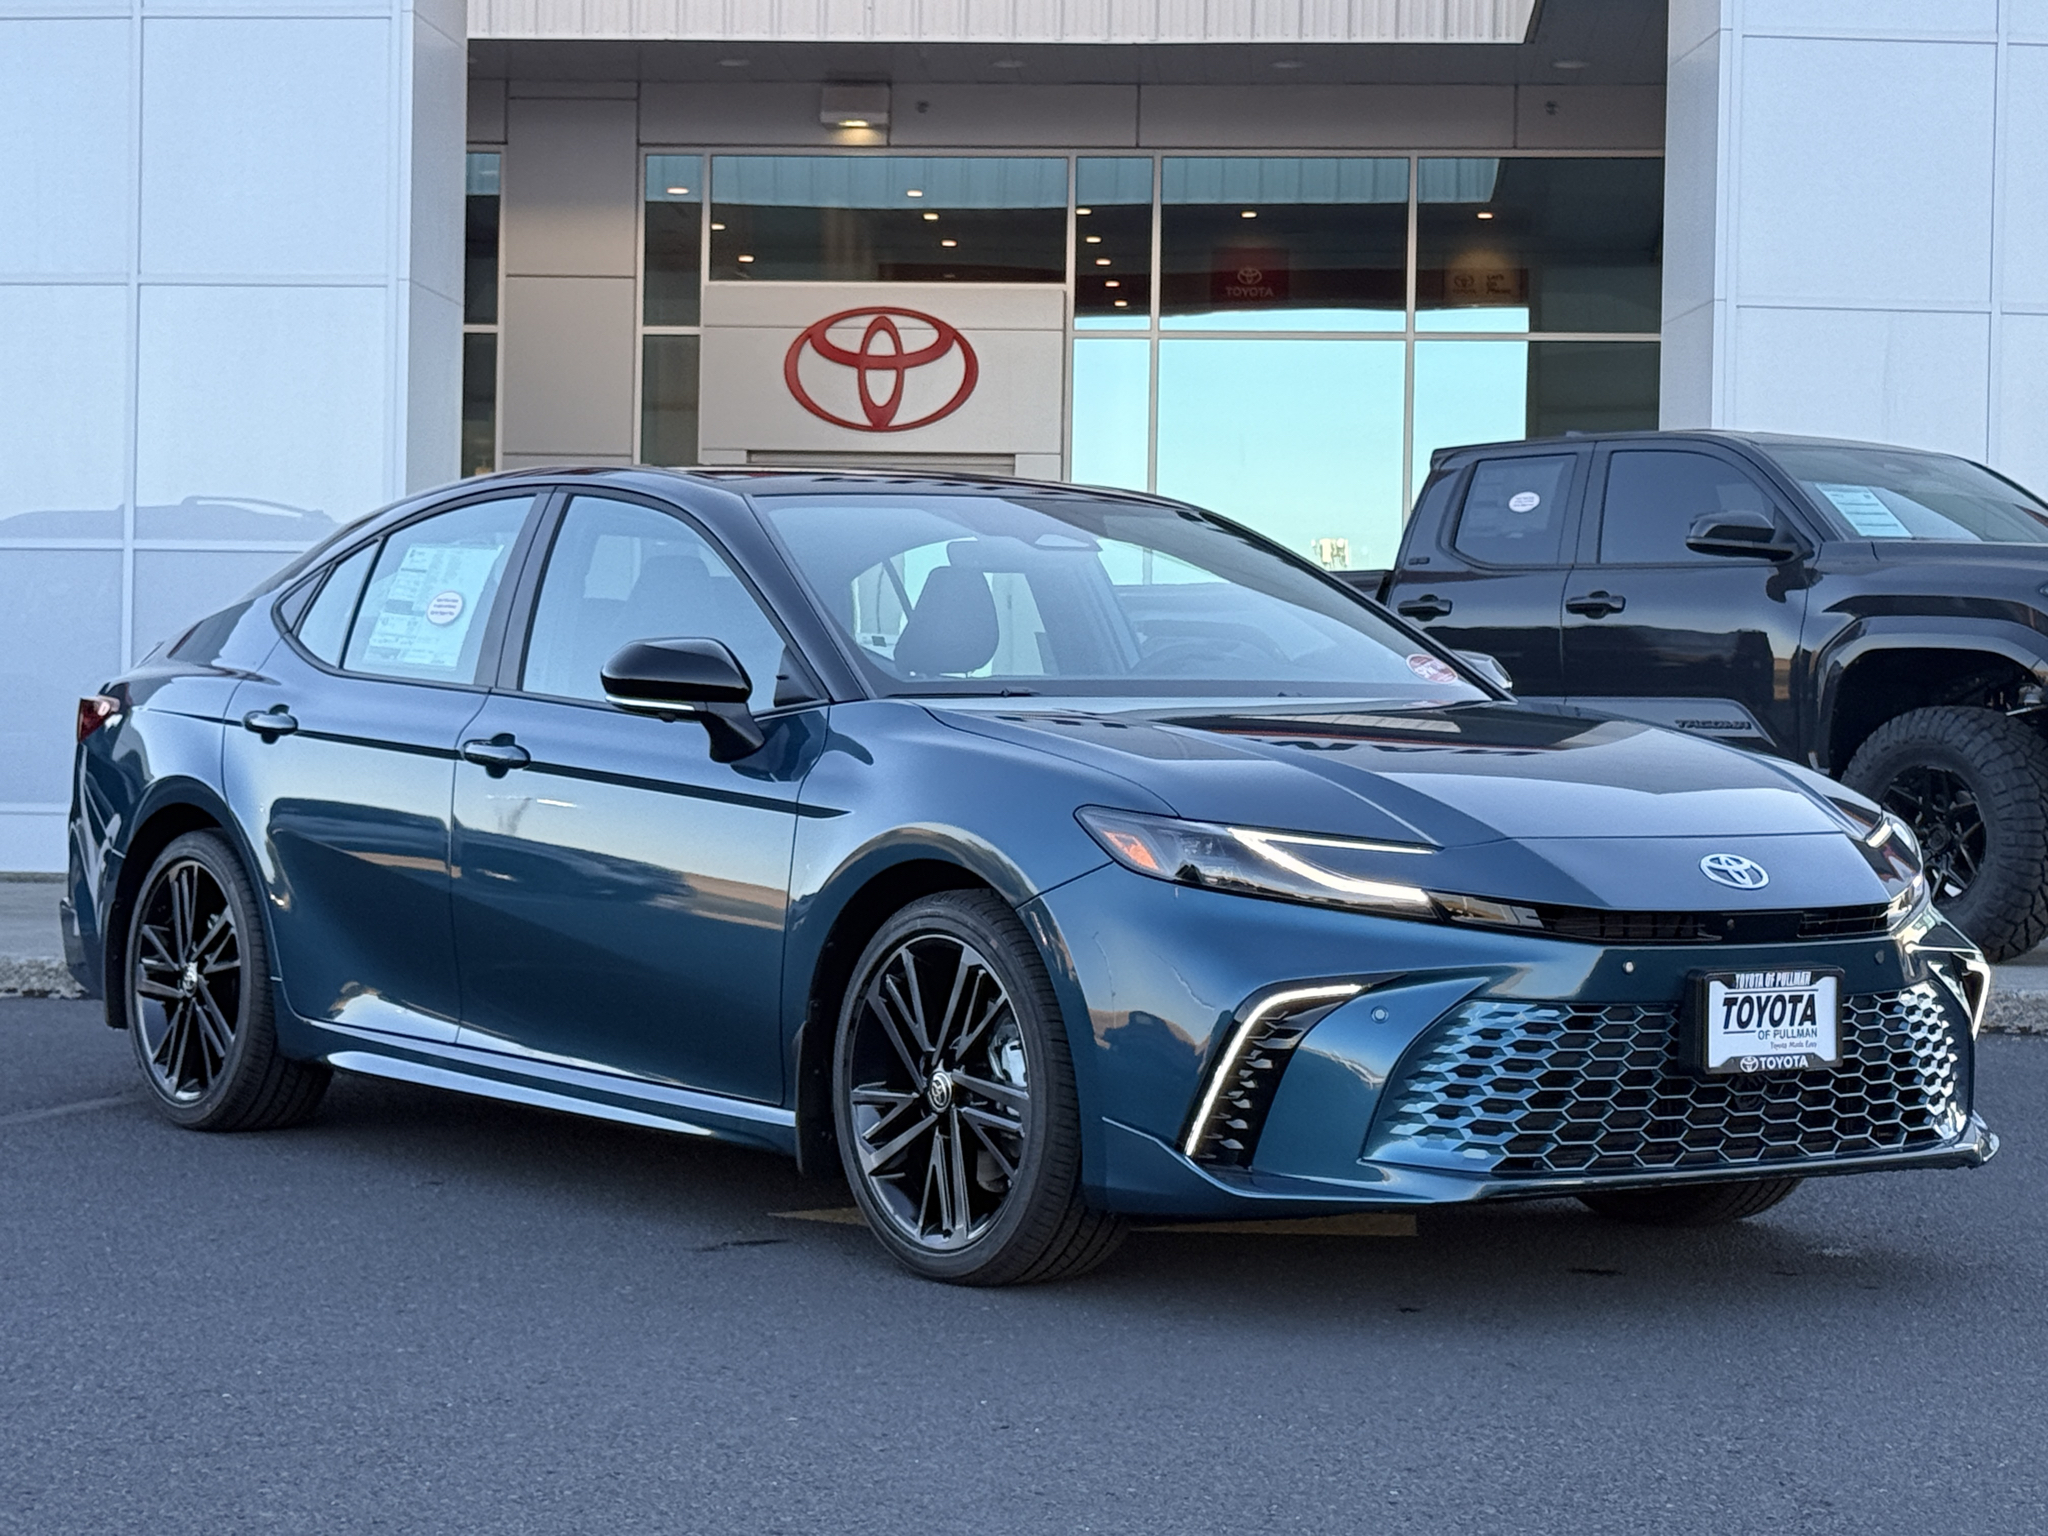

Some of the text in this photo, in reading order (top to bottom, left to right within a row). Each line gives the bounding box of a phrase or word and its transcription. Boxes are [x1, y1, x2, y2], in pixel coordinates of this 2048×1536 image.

[1225, 286, 1274, 298] TOYOTA
[1735, 972, 1764, 989] TOYOTA
[1723, 994, 1817, 1030] TOYOTA
[1757, 1028, 1818, 1041] OF PULLMAN
[1759, 1055, 1809, 1070] TOYOTA
